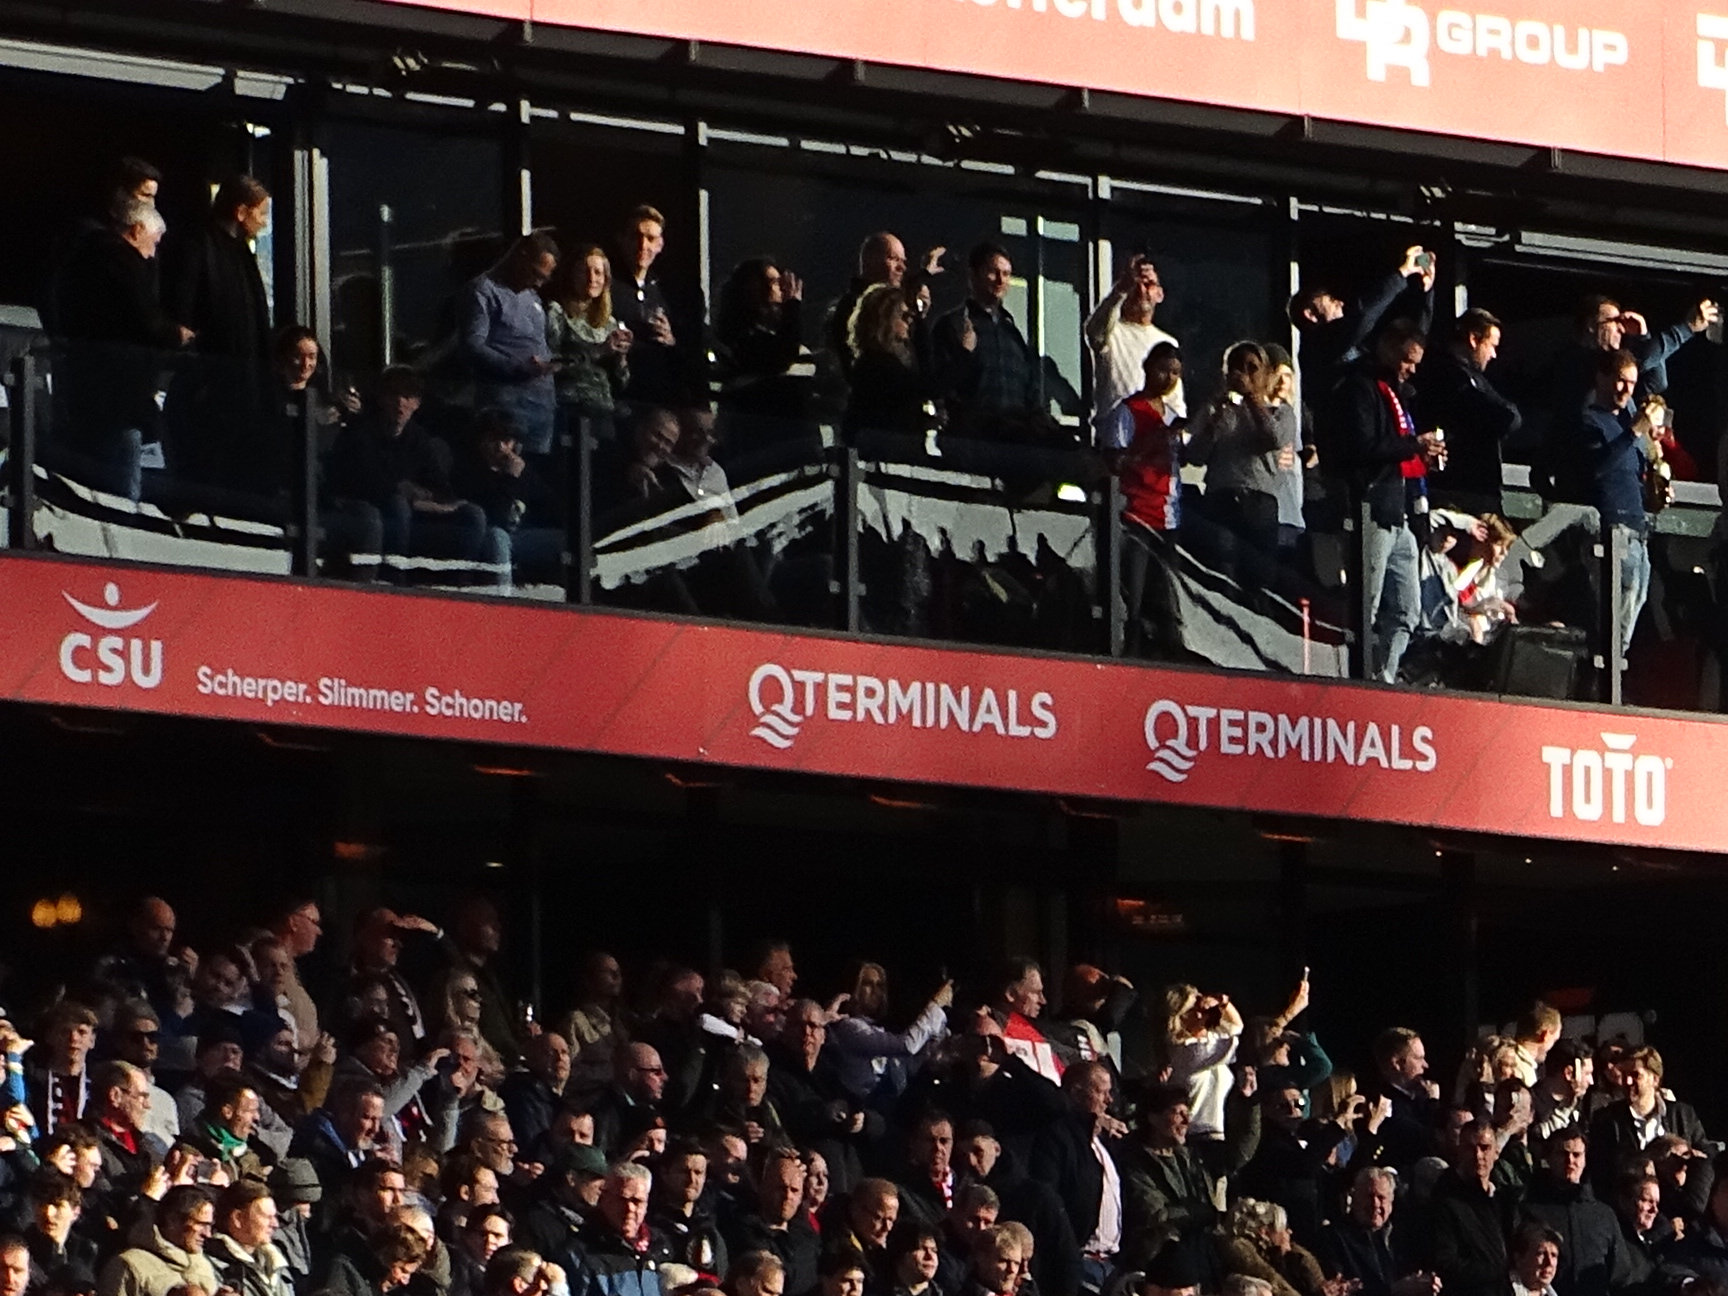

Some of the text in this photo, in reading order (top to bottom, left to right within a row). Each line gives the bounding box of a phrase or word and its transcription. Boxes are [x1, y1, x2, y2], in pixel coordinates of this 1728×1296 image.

[1436, 11, 1629, 73] GROUP
[59, 632, 163, 689] CSU
[197, 665, 528, 723] Scherper. Slimmer. Schoner.
[748, 663, 1057, 749] QTERMINALS
[1144, 699, 1437, 782] QTERMINALS
[1542, 735, 1665, 827] TOTO
